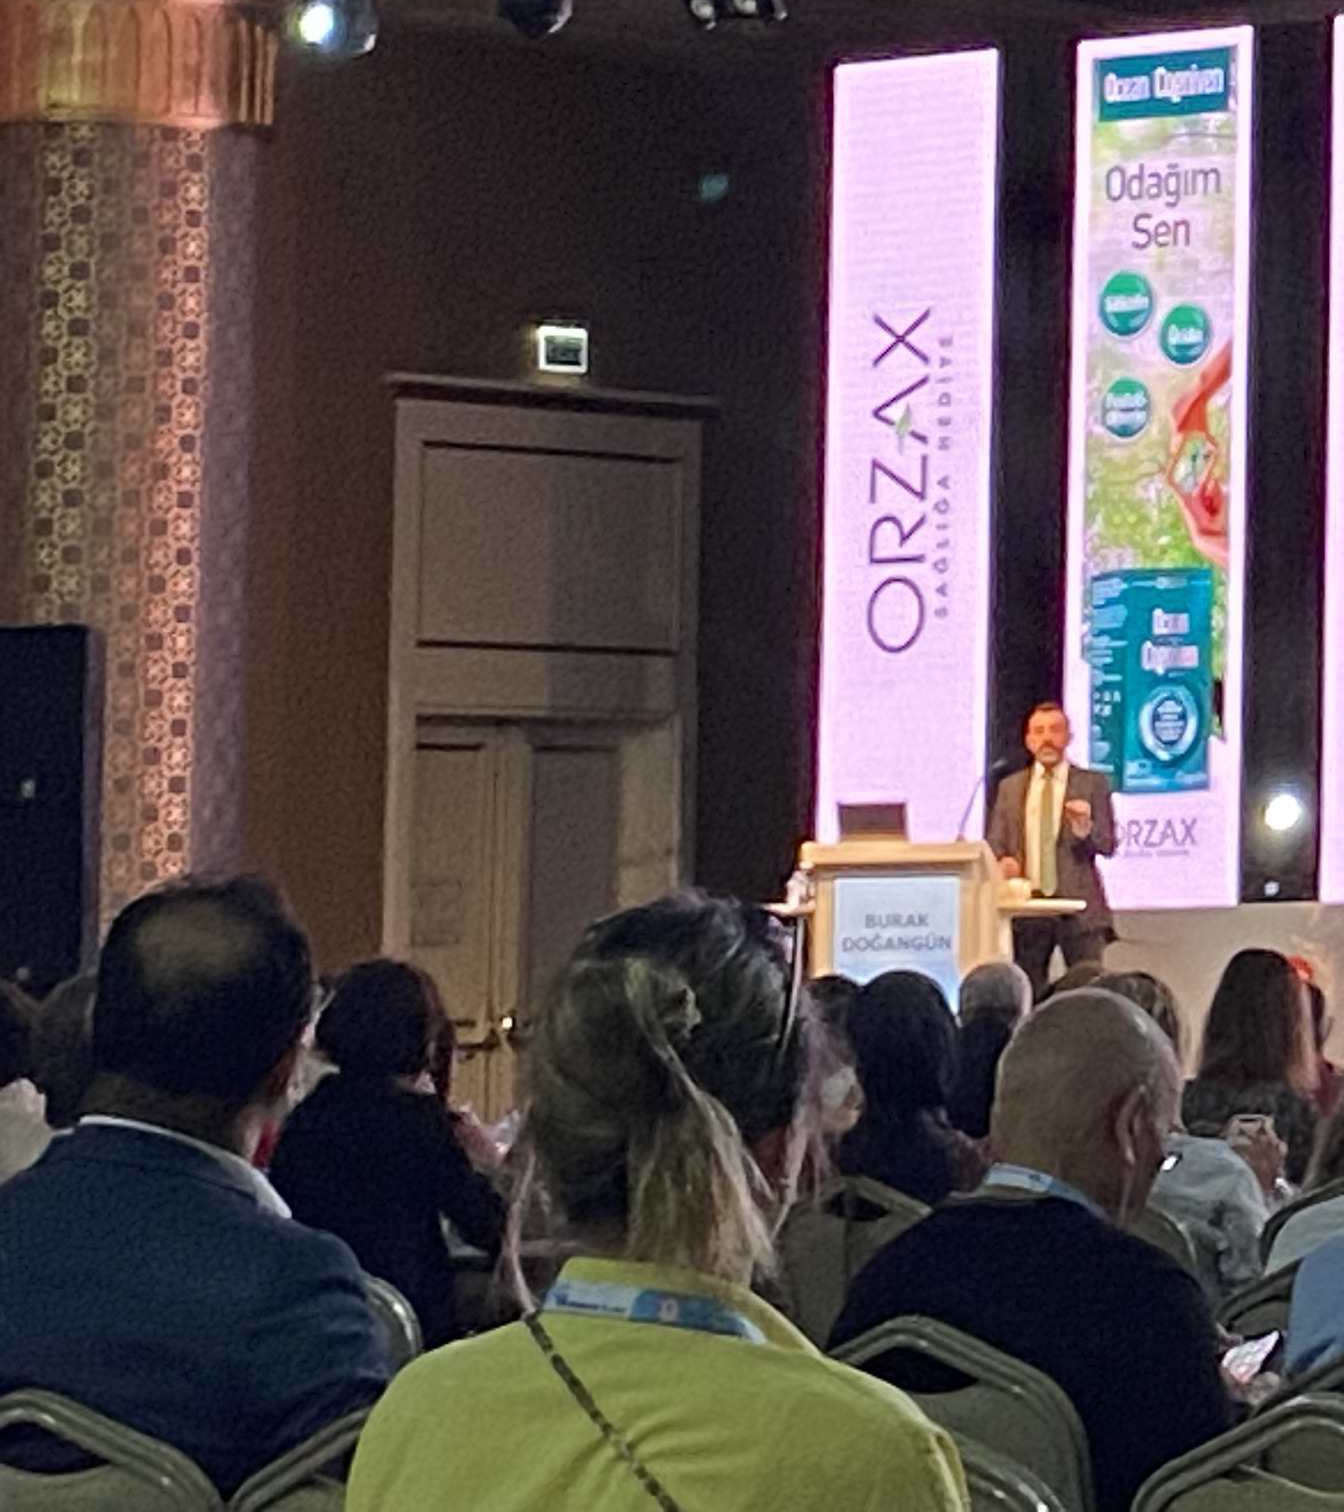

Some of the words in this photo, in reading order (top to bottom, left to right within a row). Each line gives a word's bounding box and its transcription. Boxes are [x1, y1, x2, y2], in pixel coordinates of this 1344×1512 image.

[1105, 163, 1222, 208] Odağım
[1131, 212, 1191, 250] Sen
[867, 306, 931, 654] ORZAX
[865, 913, 930, 929] BURAK
